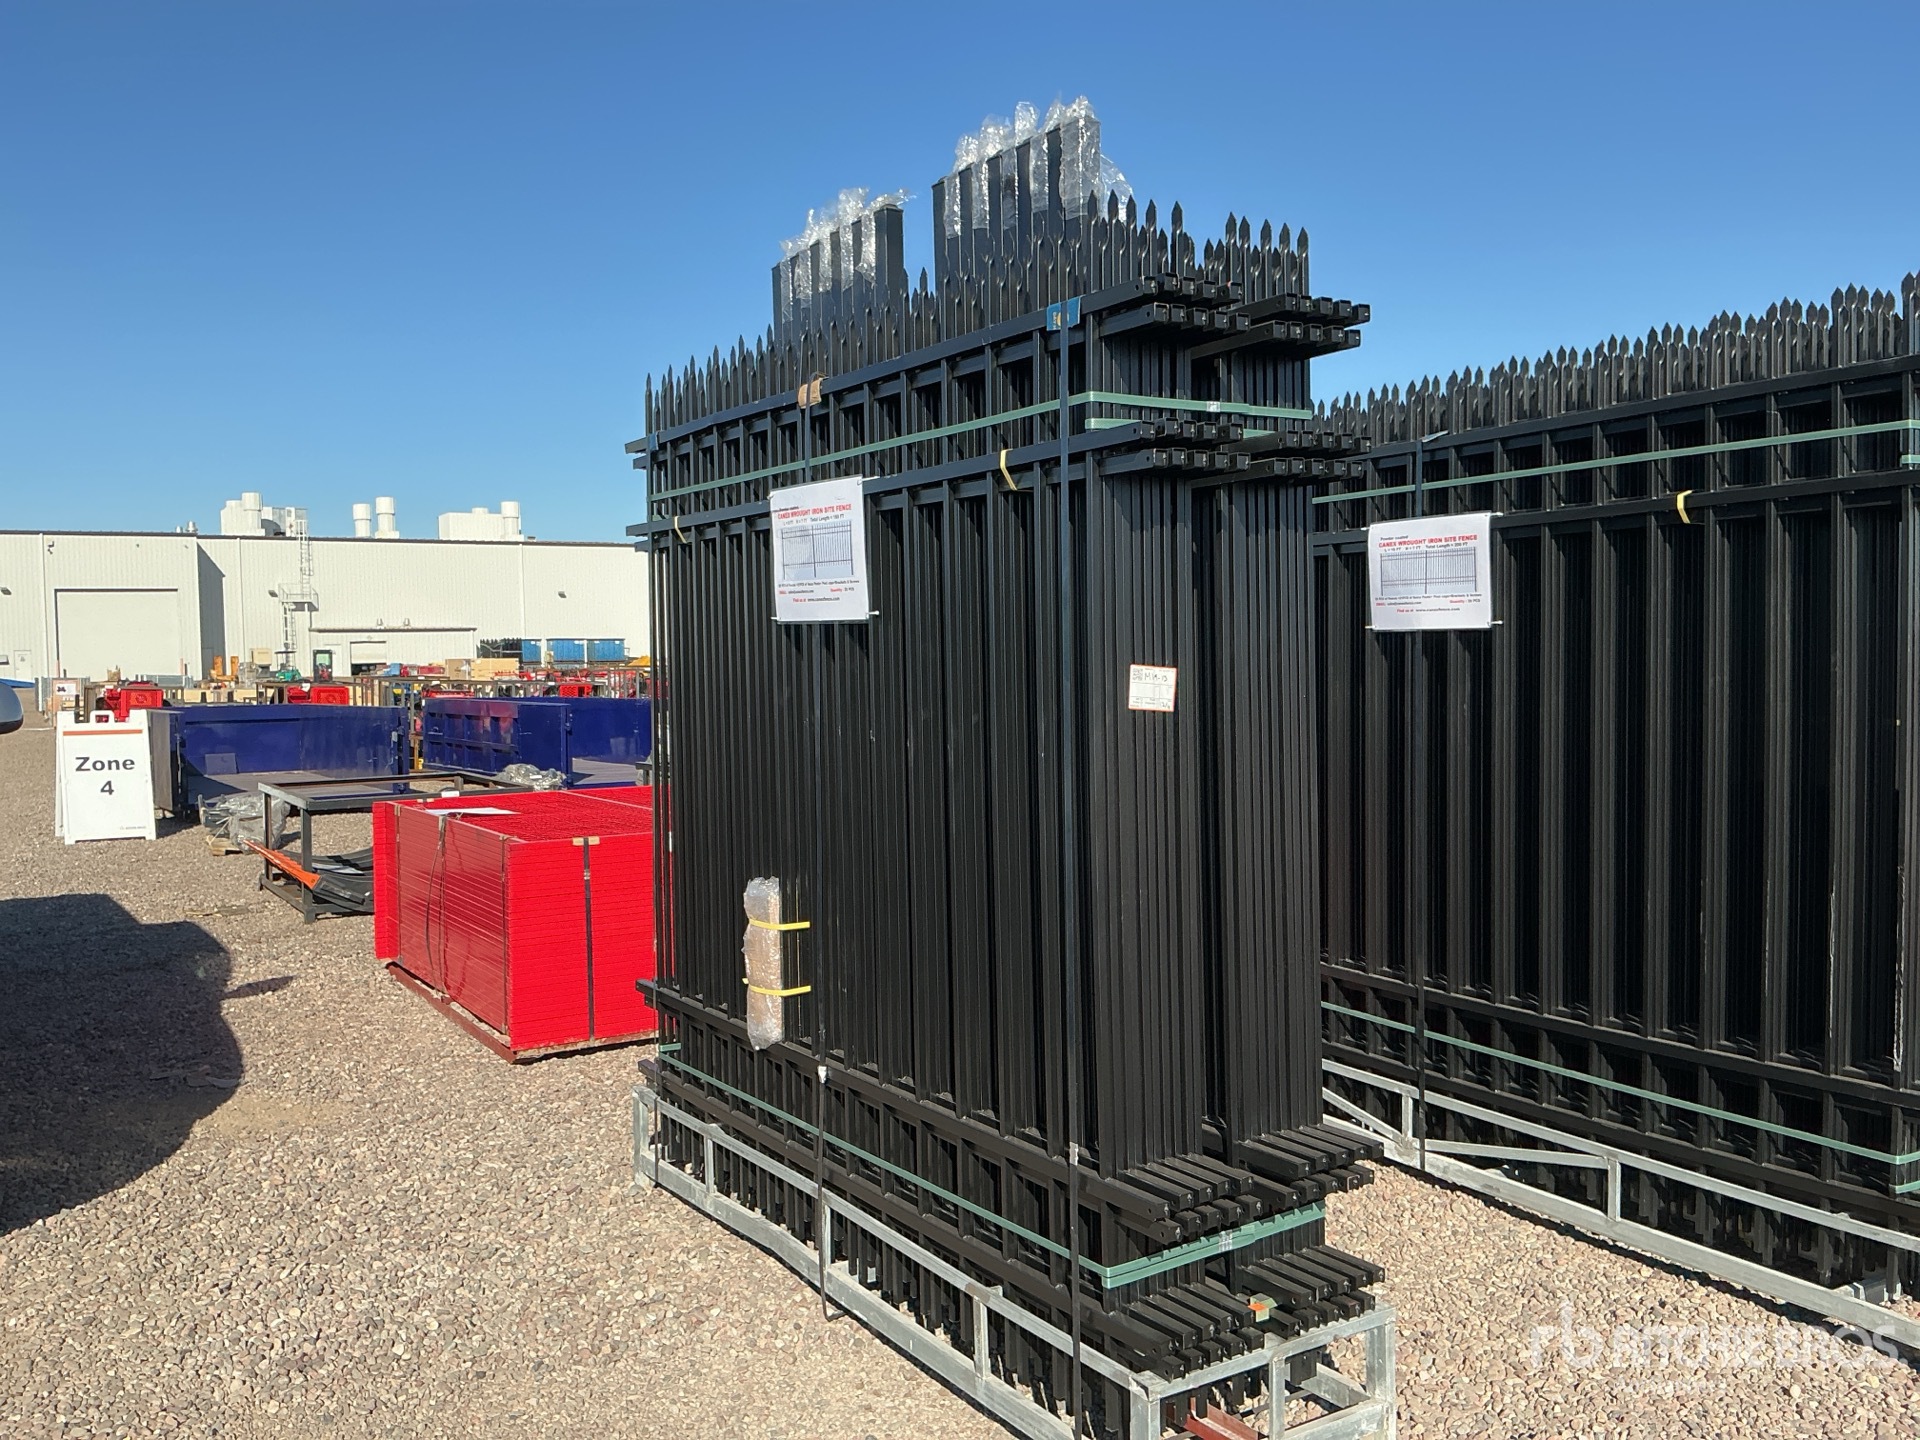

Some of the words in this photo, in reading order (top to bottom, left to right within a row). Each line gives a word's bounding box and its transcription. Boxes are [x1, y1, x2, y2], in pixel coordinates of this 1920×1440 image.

[791, 509, 810, 518] WROUGHT
[836, 504, 852, 512] FENCE
[1398, 538, 1425, 546] WROUGHT
[75, 757, 136, 772] Zone
[100, 780, 115, 796] 4
